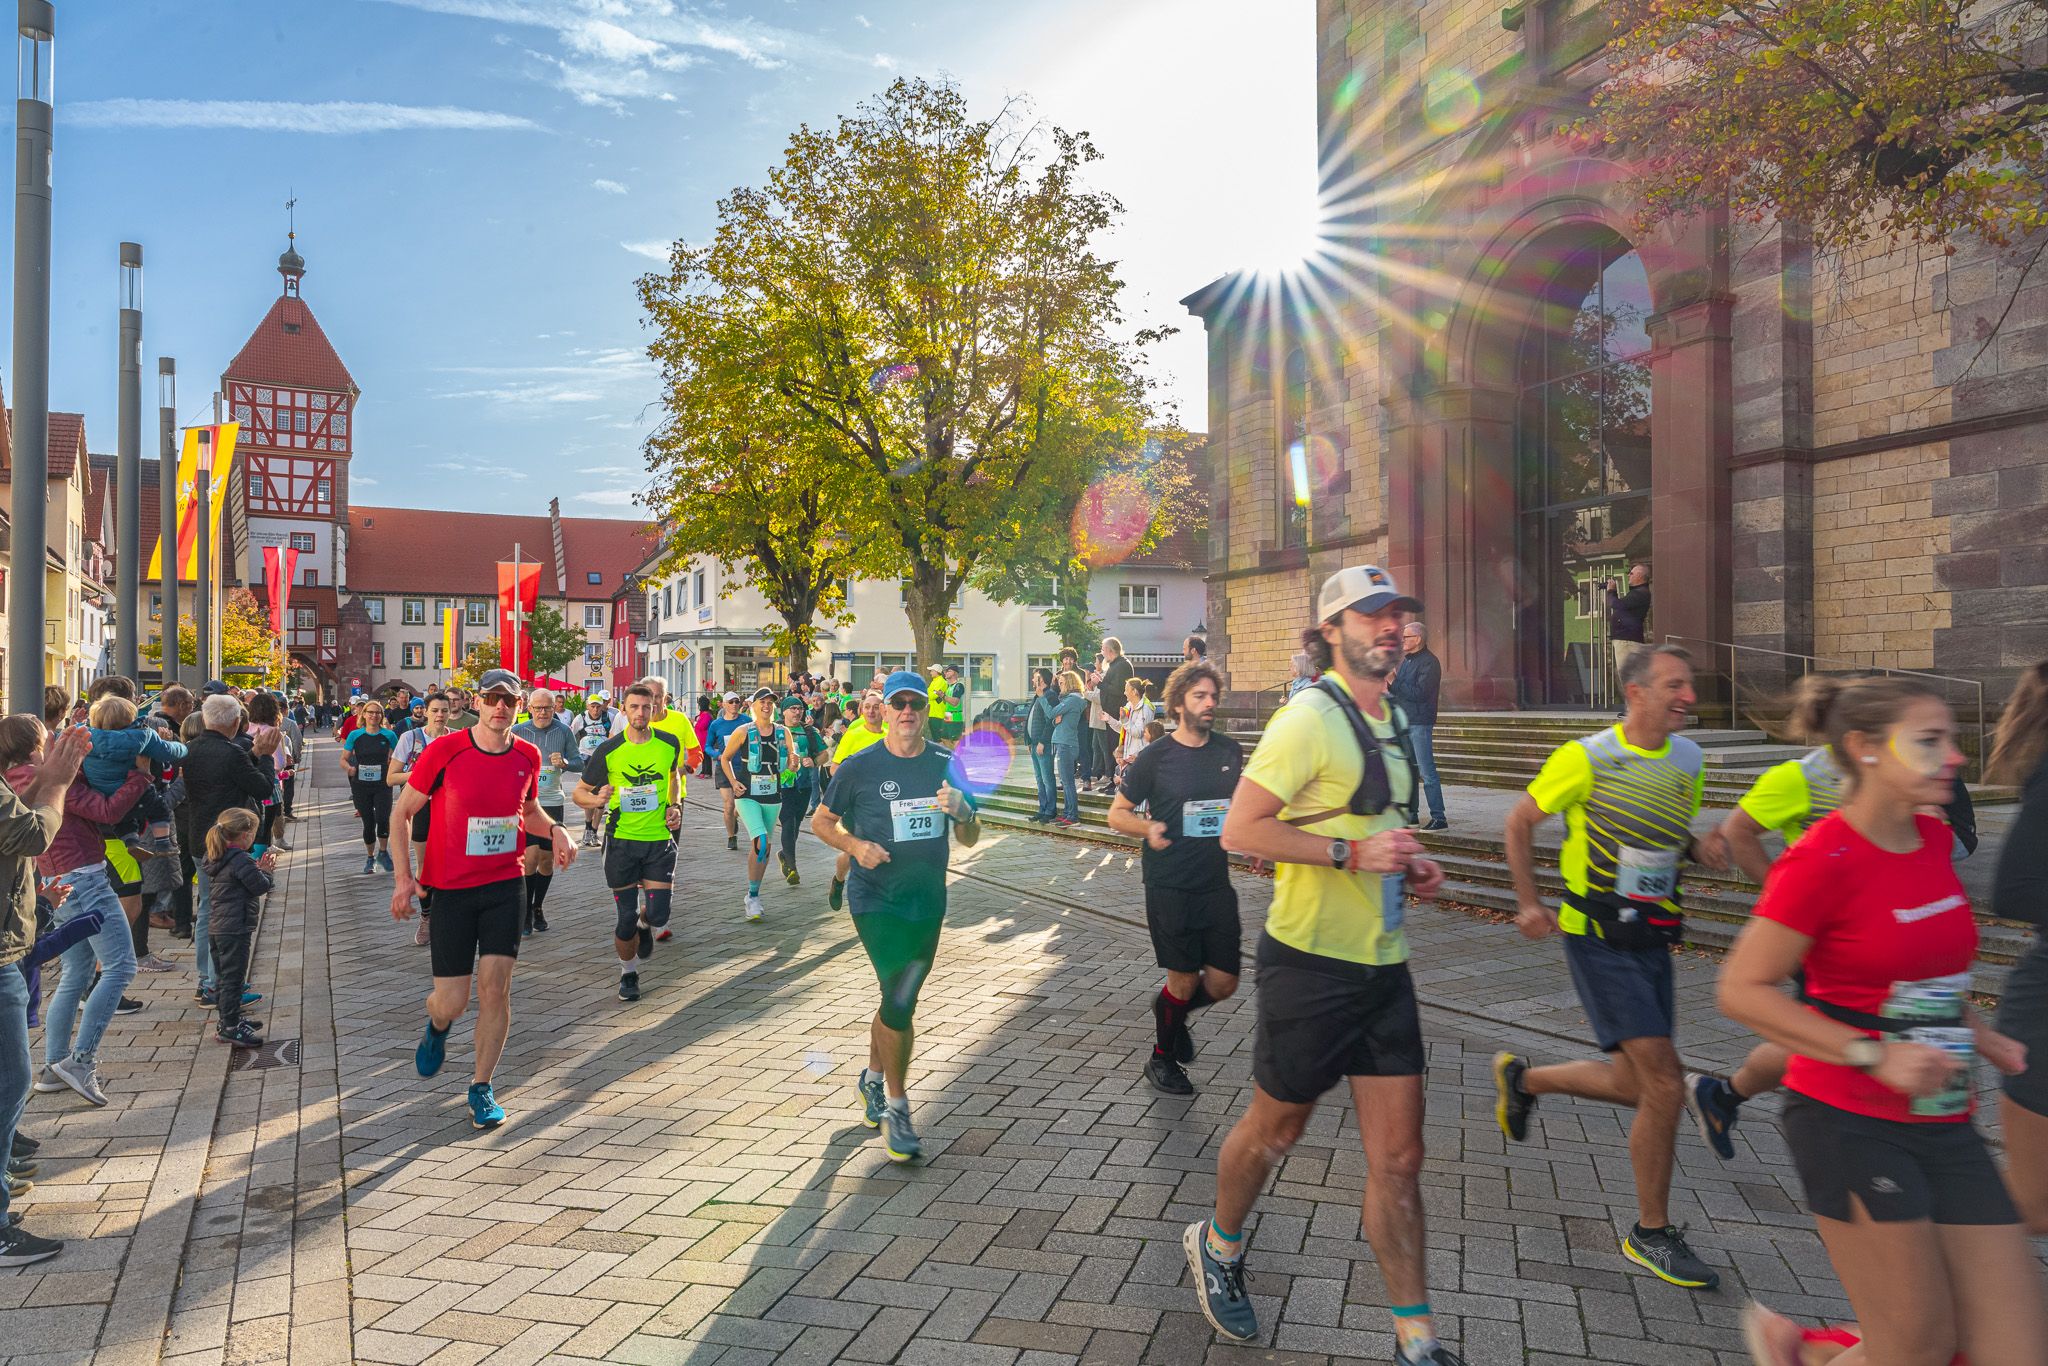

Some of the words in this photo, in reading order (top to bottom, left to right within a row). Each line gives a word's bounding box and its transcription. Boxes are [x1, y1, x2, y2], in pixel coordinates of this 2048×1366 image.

[630, 797, 647, 806] 356
[909, 816, 932, 830] 278
[1199, 816, 1219, 828] 490
[484, 833, 506, 847] 372
